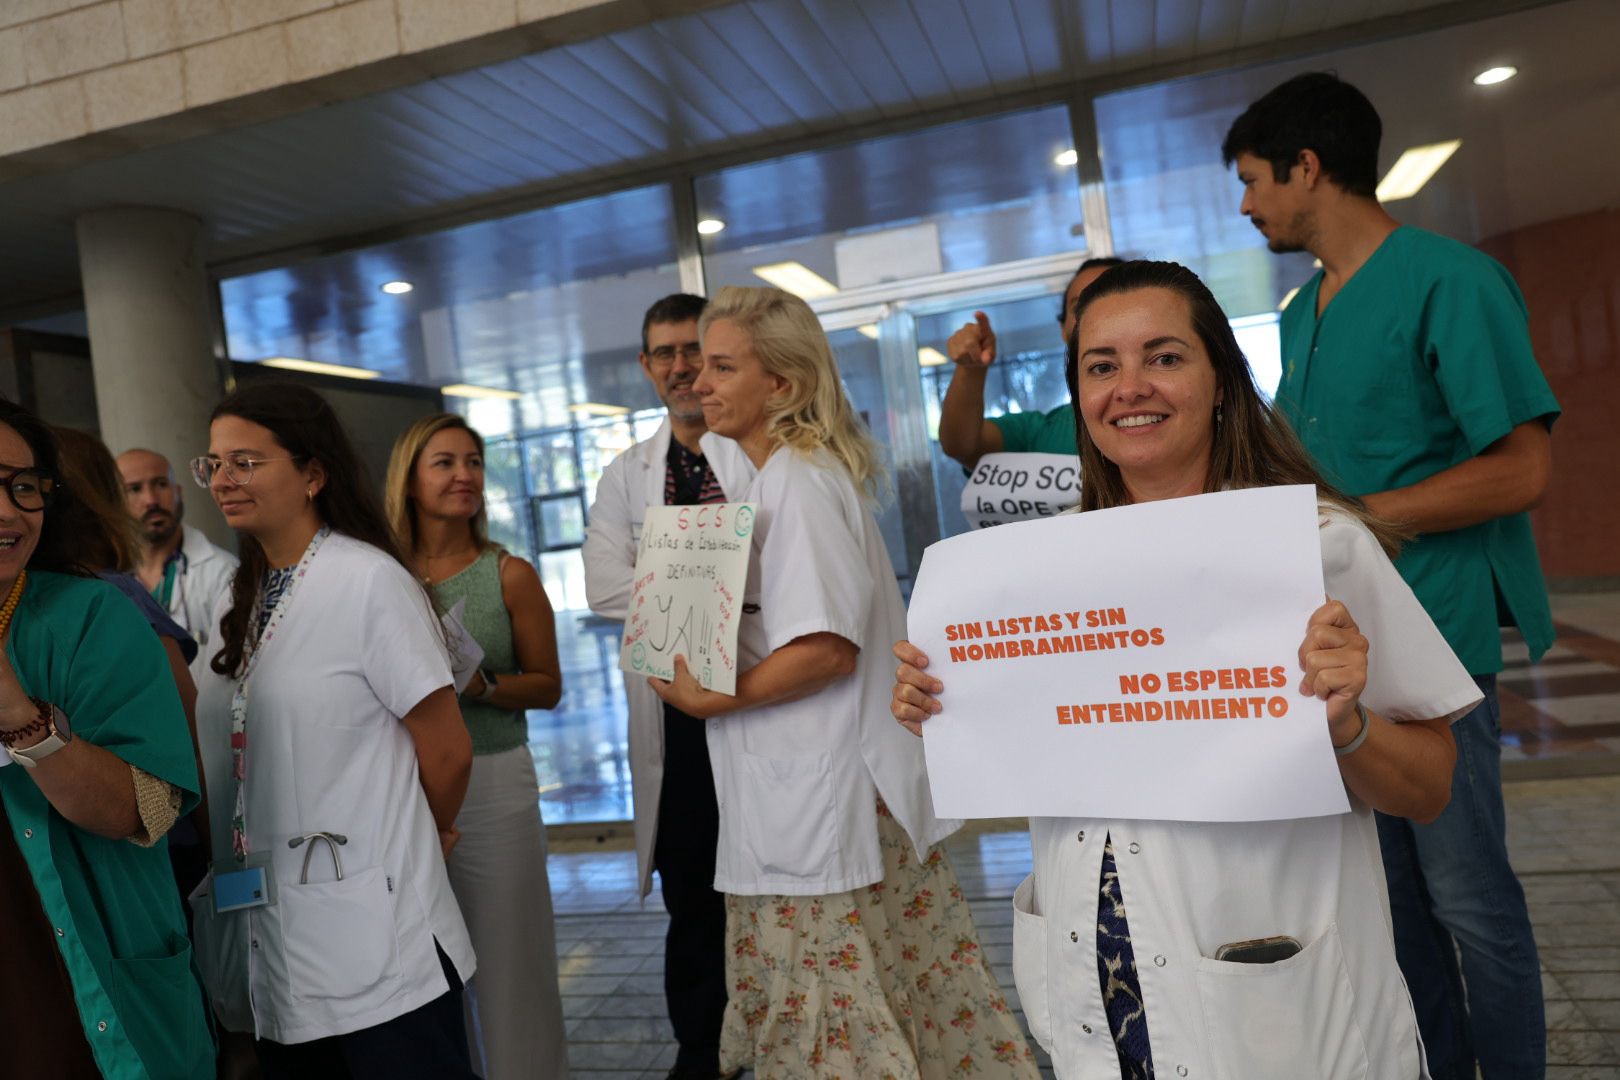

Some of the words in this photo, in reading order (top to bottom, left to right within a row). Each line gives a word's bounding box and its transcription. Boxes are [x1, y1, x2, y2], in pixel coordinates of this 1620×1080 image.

[973, 464, 1028, 493] Stop
[977, 496, 996, 514] la
[1001, 499, 1053, 516] OPE
[684, 538, 694, 550] de
[945, 621, 984, 641] SIN
[986, 613, 1063, 638] LISTAS
[1065, 612, 1080, 629] Y
[1085, 607, 1127, 628] SIN
[949, 627, 1165, 662] NOMBRAMIENTOS
[1119, 672, 1162, 695] NO
[1167, 666, 1288, 692] ESPERES
[1056, 696, 1289, 725] ENTENDIMIENTO
